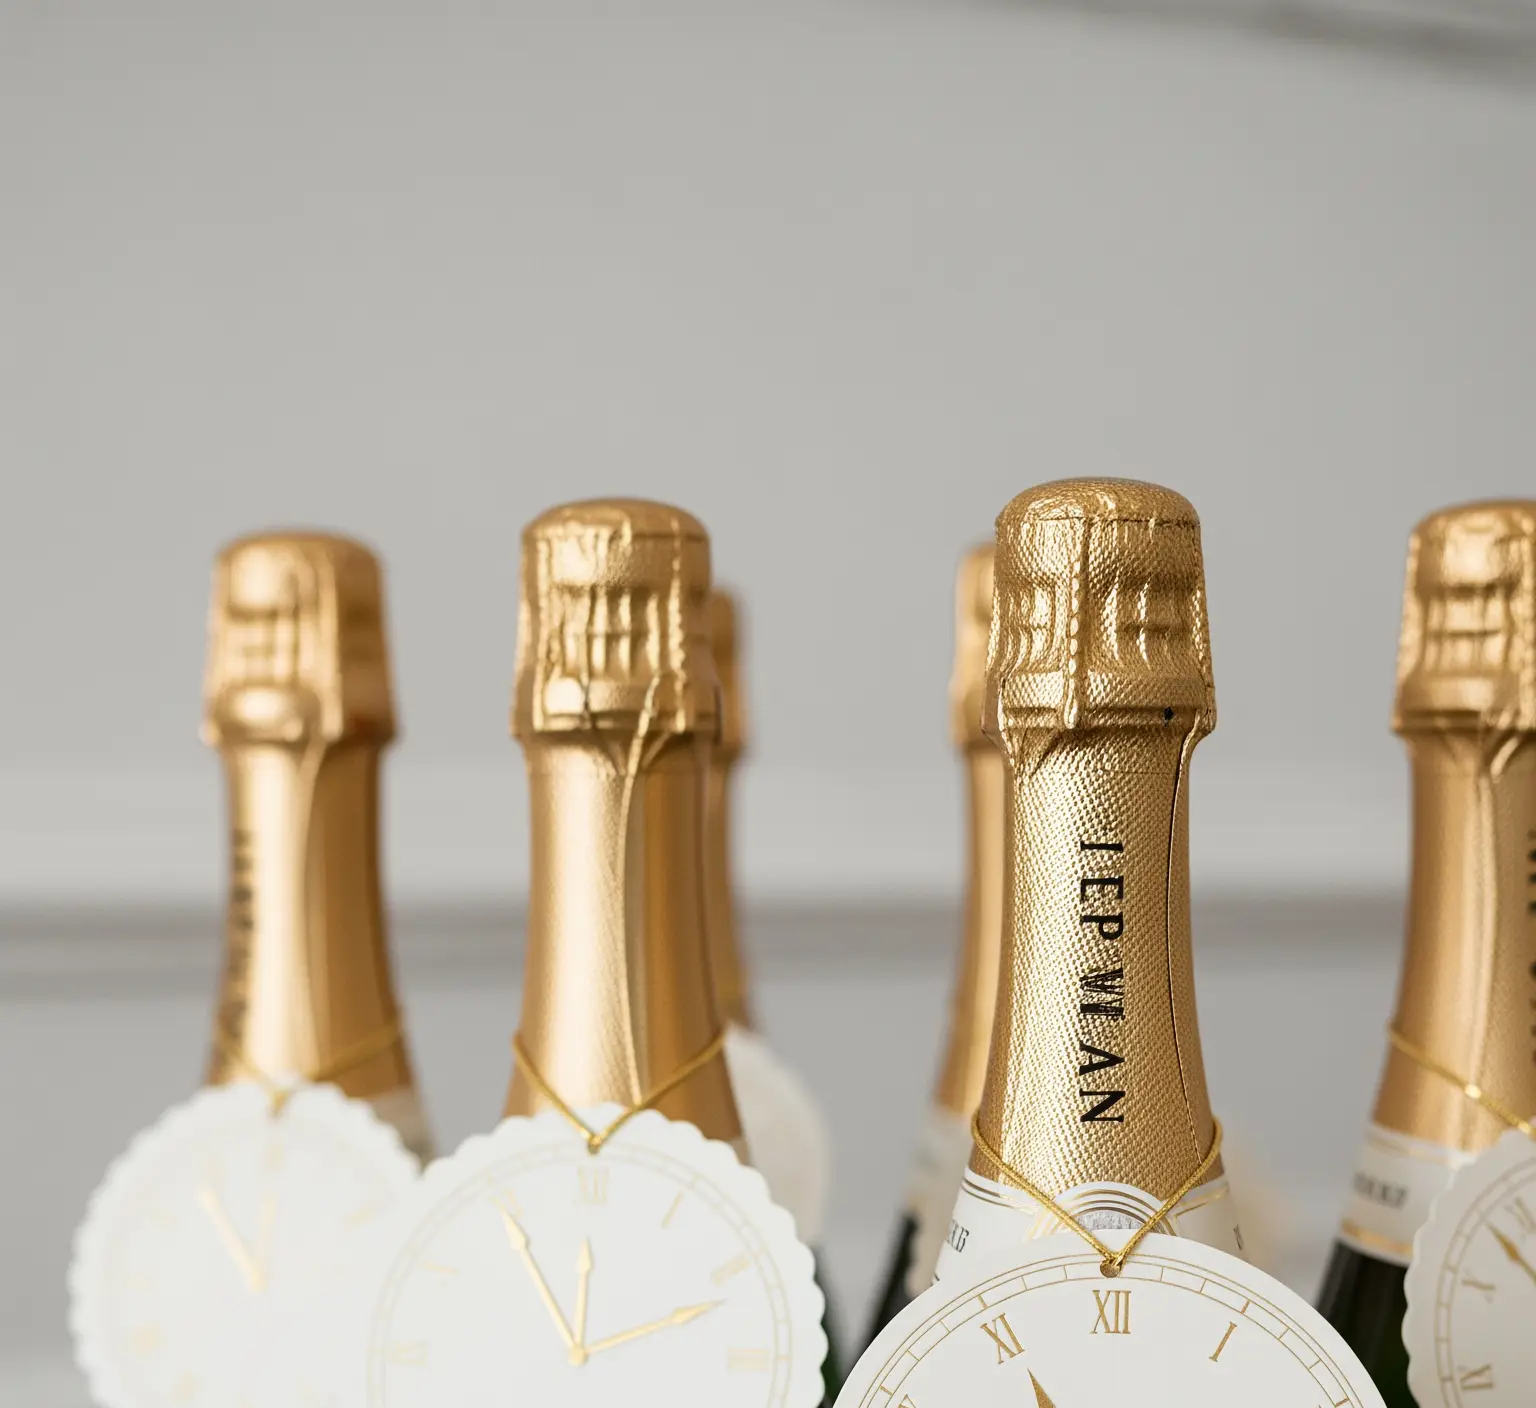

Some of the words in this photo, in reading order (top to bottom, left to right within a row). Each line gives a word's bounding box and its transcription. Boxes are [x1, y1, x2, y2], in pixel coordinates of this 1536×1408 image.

[1090, 1290, 1131, 1335] XII
[980, 1313, 1025, 1365] XI
[1208, 1321, 1237, 1363] I
